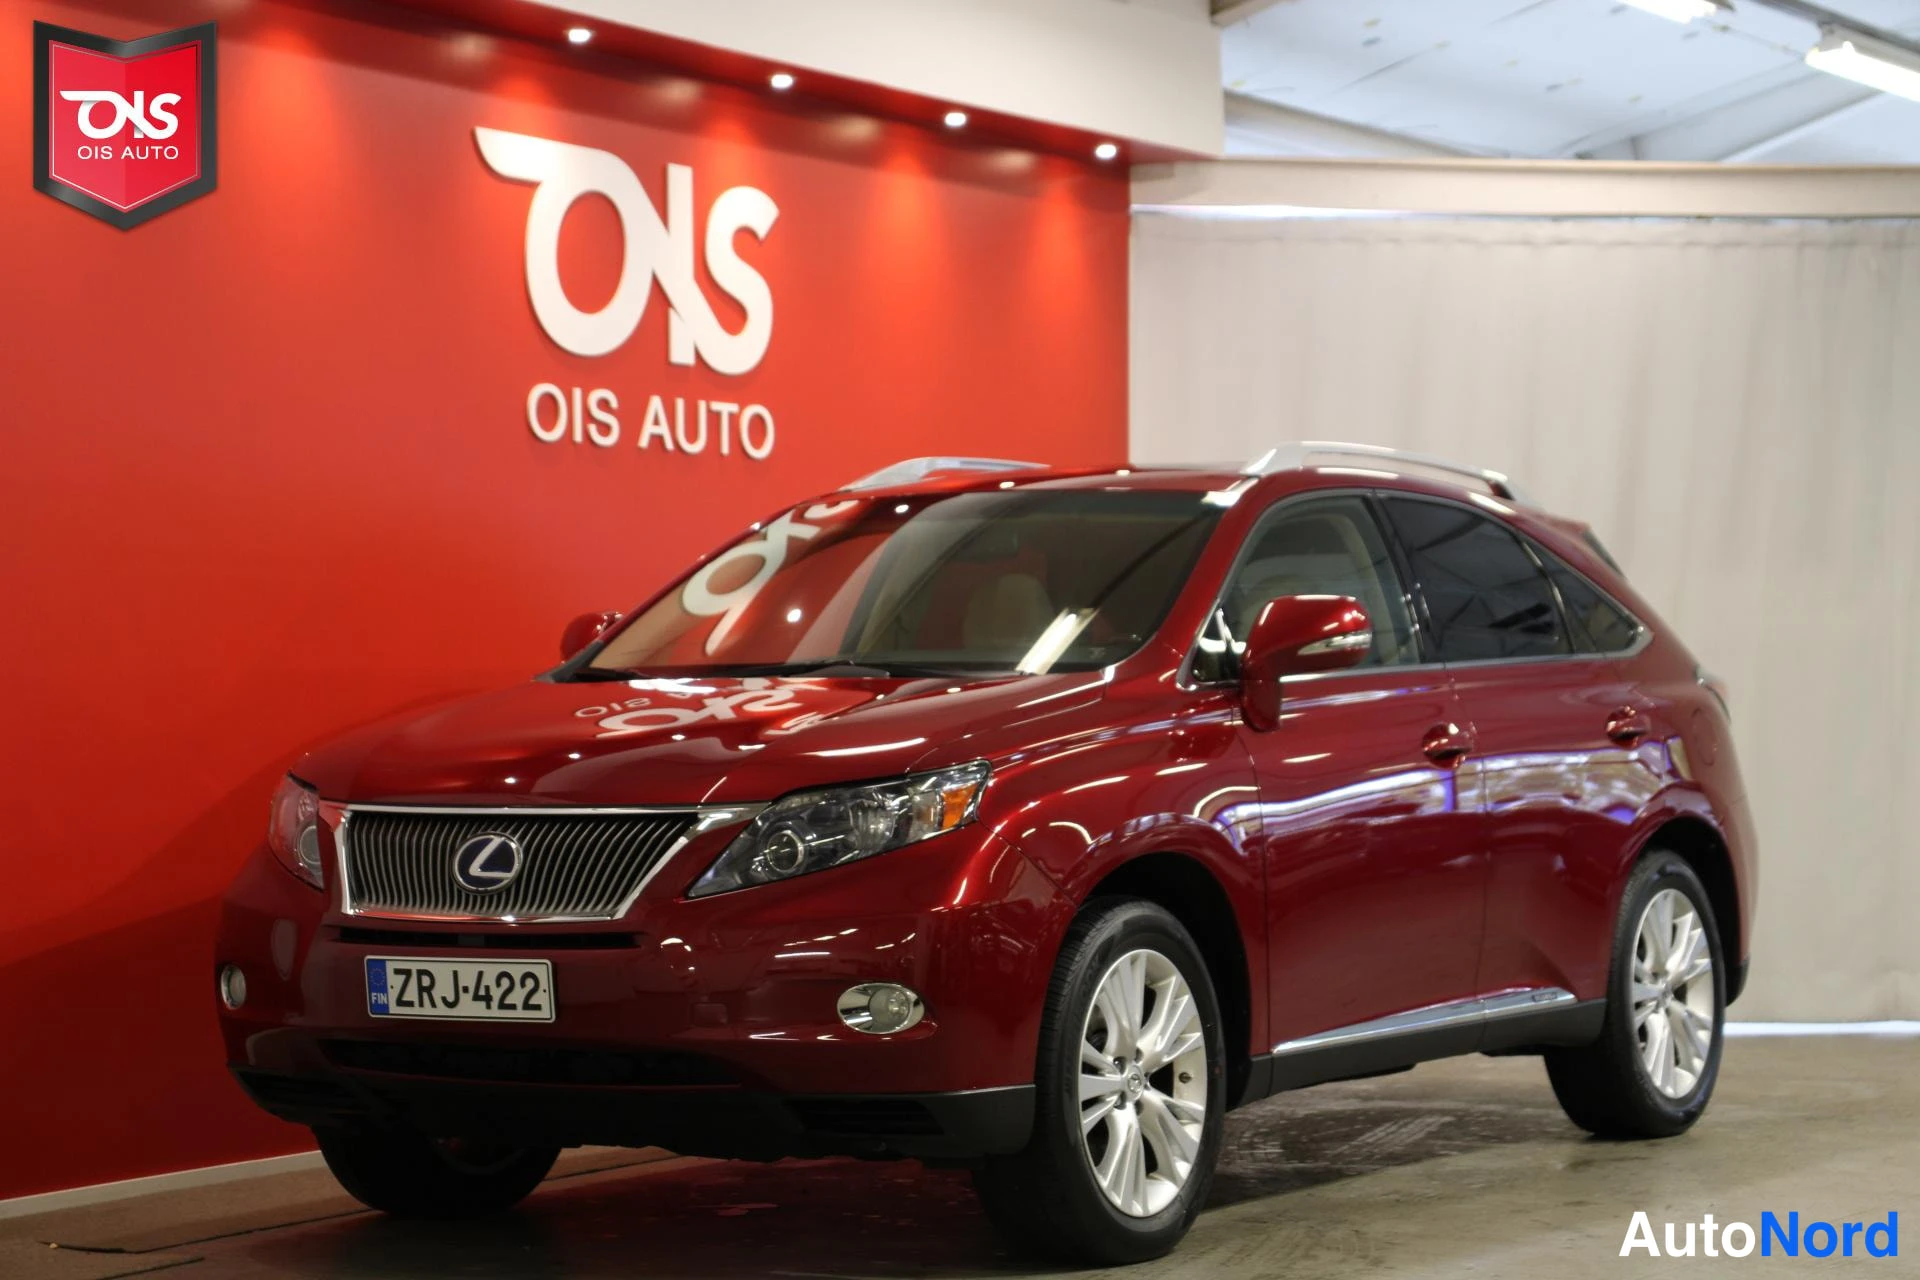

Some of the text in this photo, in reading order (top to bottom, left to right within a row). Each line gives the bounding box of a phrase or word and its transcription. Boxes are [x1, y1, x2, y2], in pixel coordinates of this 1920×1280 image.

[526, 382, 776, 460] OIS AUTO
[371, 991, 388, 1005] FIN
[393, 967, 542, 1011] ZRJ-422
